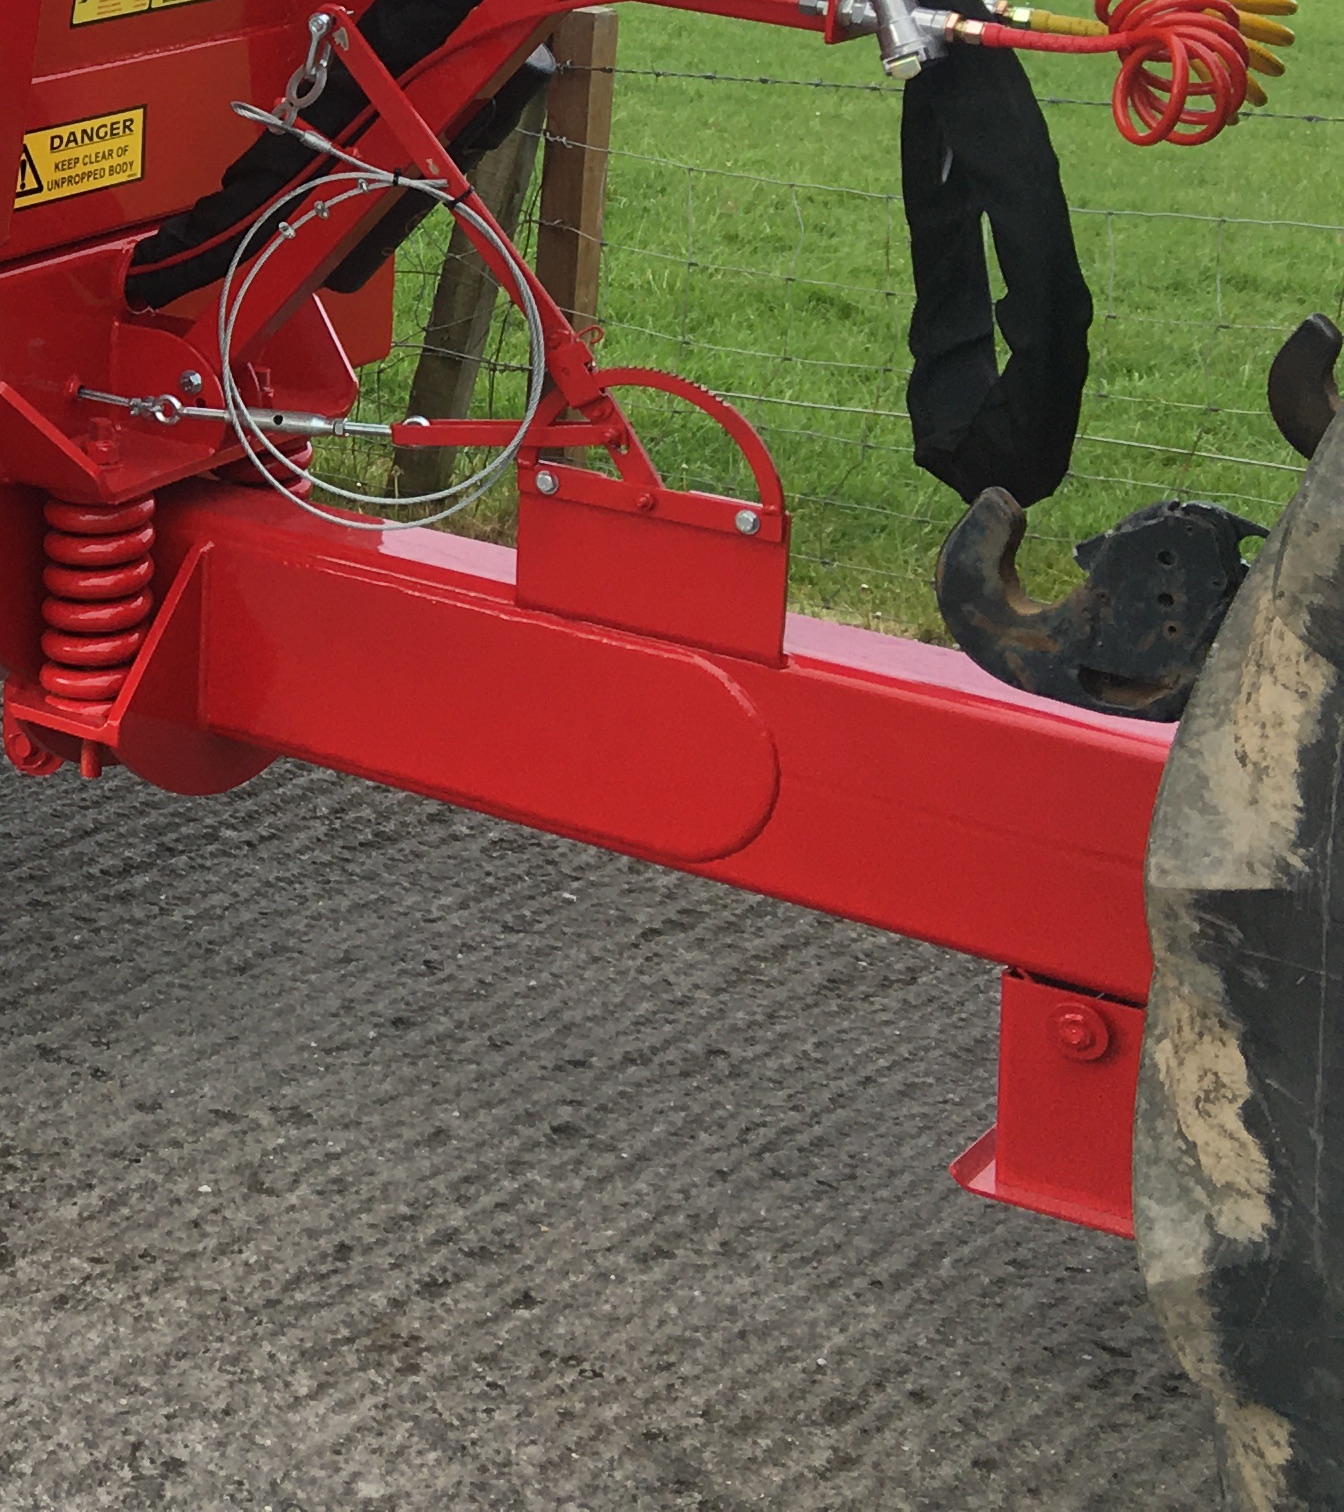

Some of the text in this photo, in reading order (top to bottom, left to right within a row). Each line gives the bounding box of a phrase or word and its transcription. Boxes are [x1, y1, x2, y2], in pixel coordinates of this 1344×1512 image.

[50, 118, 134, 151] DANGER
[54, 145, 129, 173] KEEP CLEAR OF
[47, 160, 135, 192] UNPROPPED BODY
